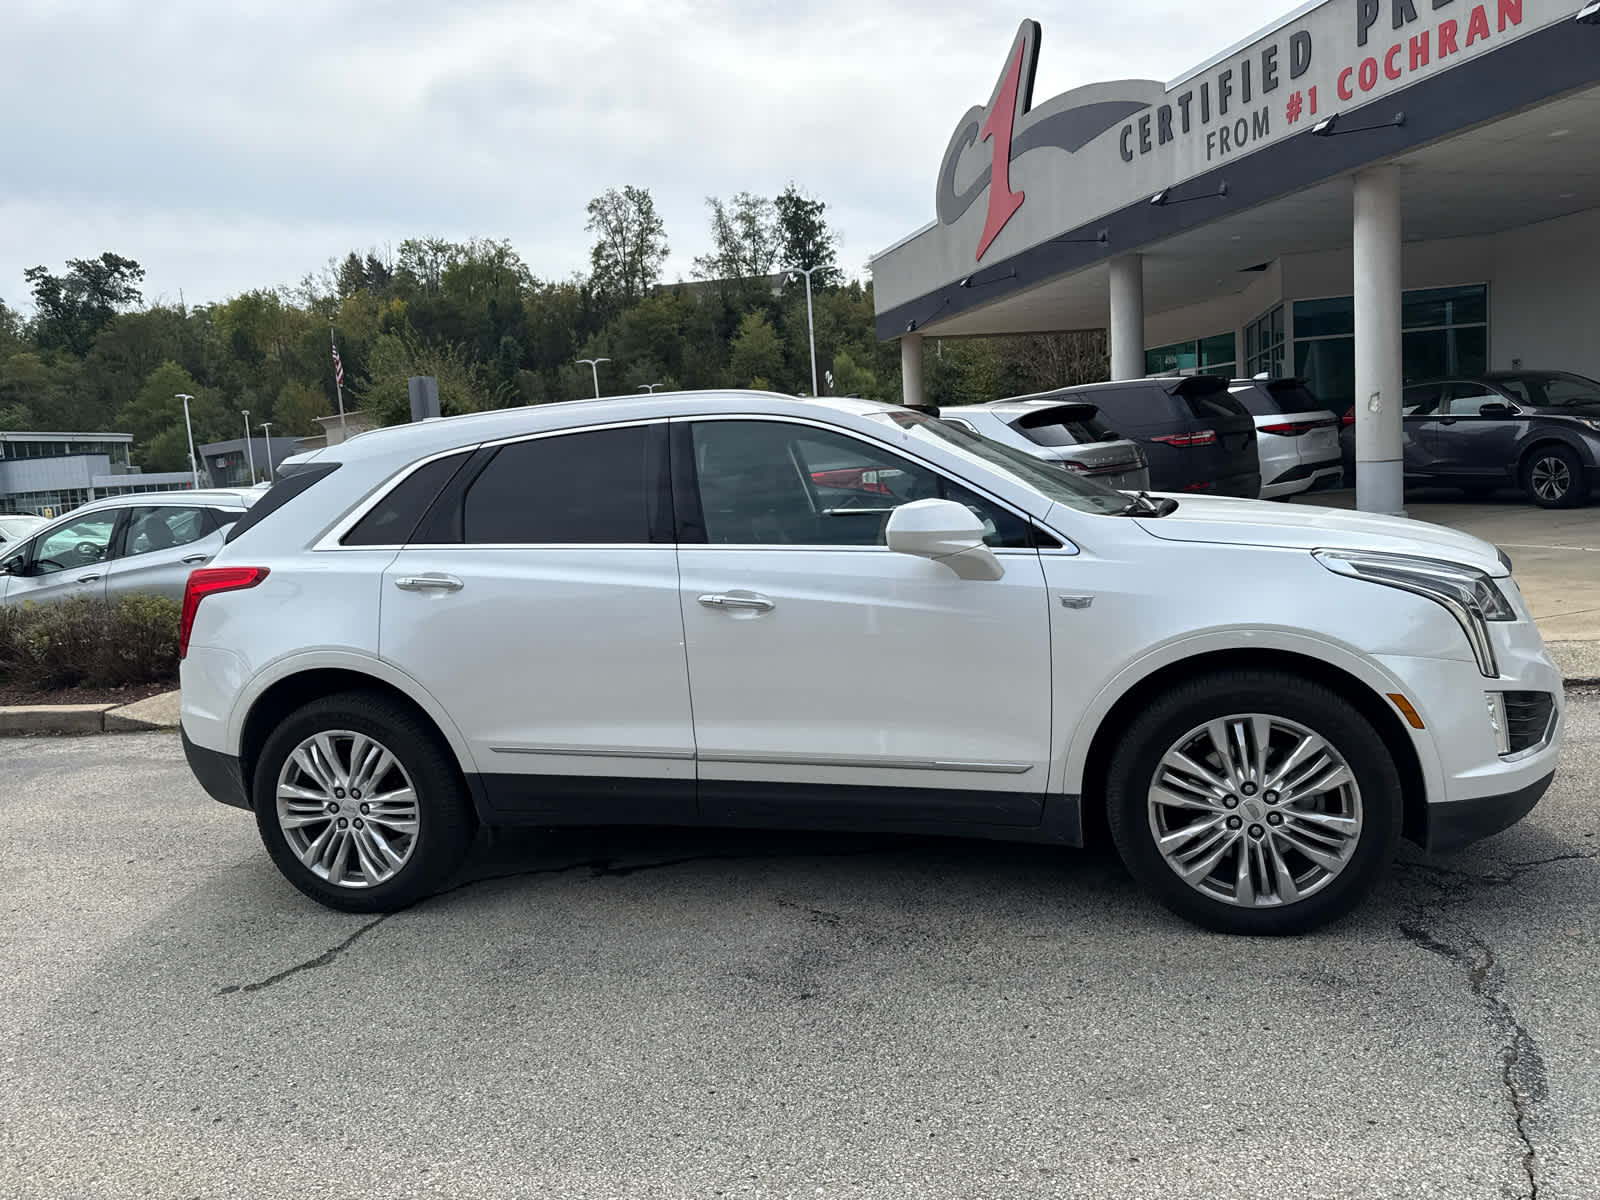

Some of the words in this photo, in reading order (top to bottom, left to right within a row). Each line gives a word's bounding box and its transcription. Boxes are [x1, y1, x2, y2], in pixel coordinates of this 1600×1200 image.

[1119, 30, 1312, 162] CERTIFIED
[1206, 106, 1270, 161] FROM
[1285, 85, 1317, 125] #1
[1336, 0, 1522, 101] COCHRAN
